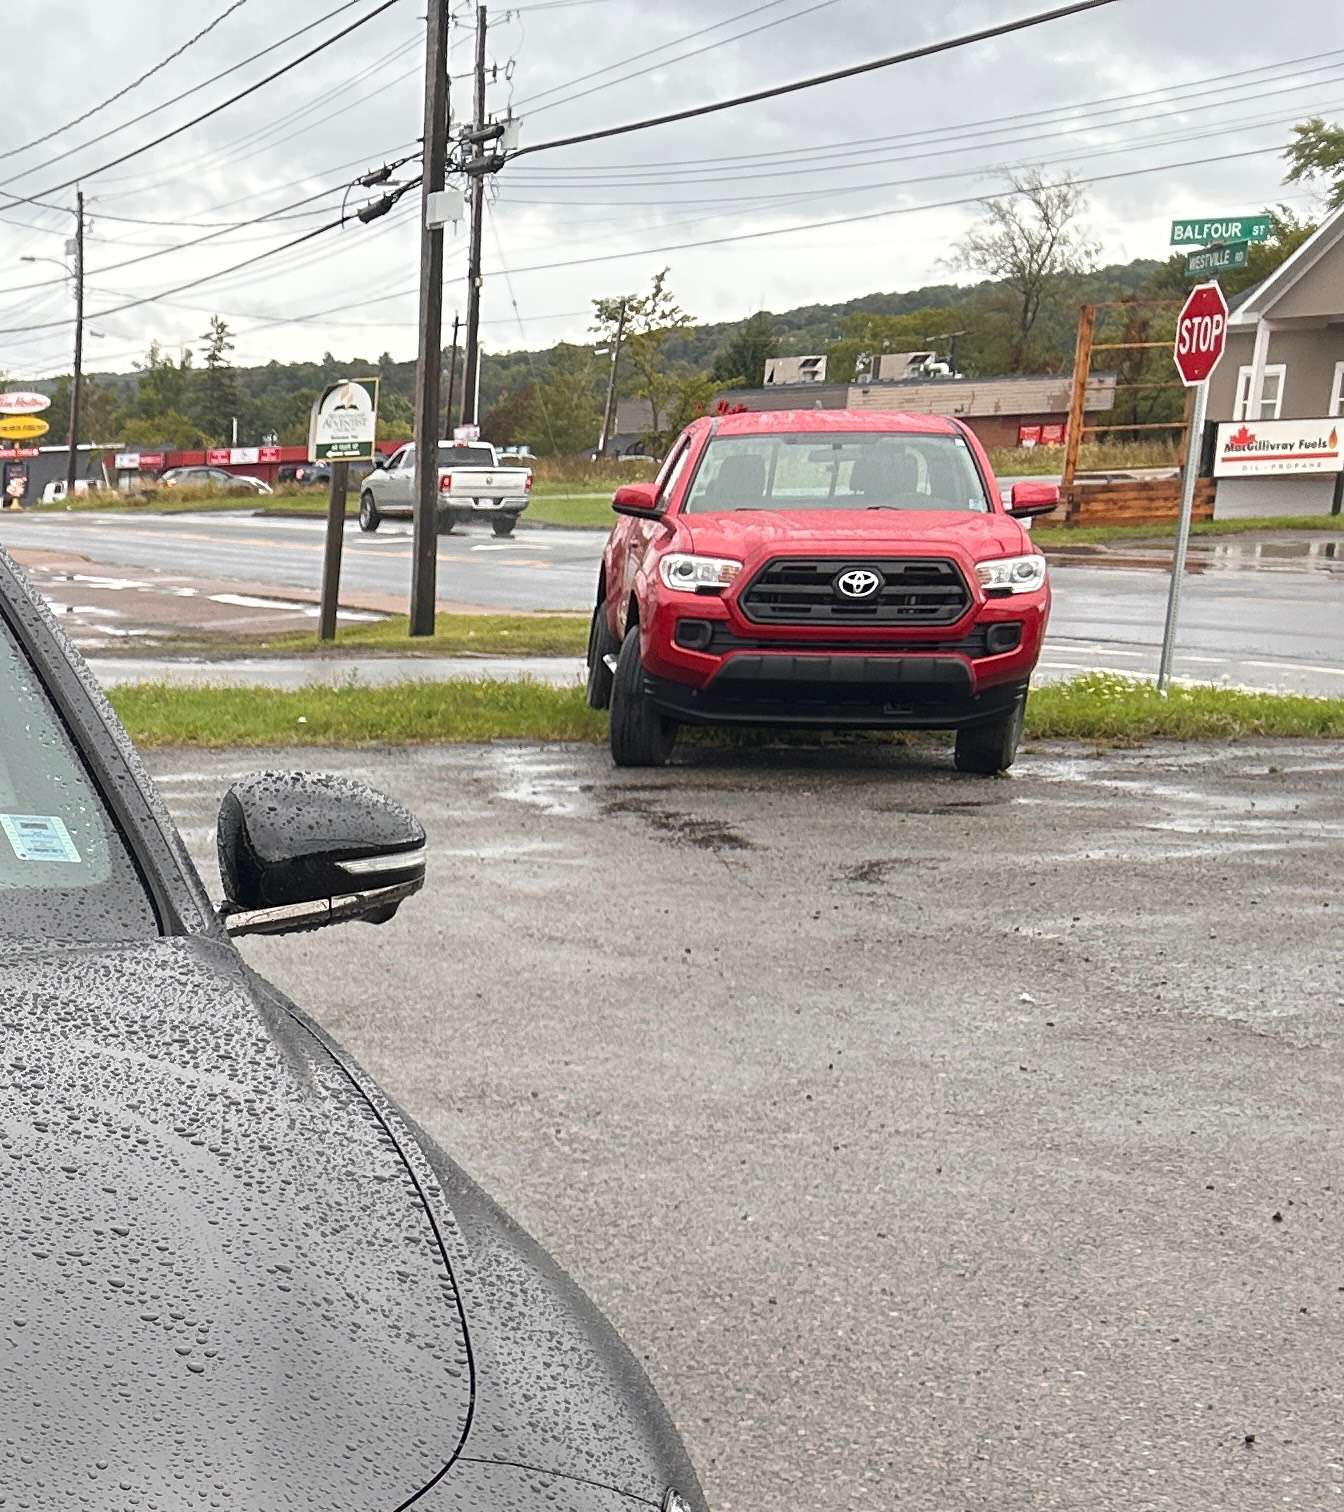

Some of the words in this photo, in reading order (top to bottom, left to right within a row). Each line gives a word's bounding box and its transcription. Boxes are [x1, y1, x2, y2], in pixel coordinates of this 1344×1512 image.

[1173, 222, 1242, 241] BALFOUR
[1252, 224, 1266, 236] ST
[1189, 249, 1231, 271] WESTVILLE
[1179, 314, 1223, 355] STOP
[1298, 437, 1328, 450] Fuels
